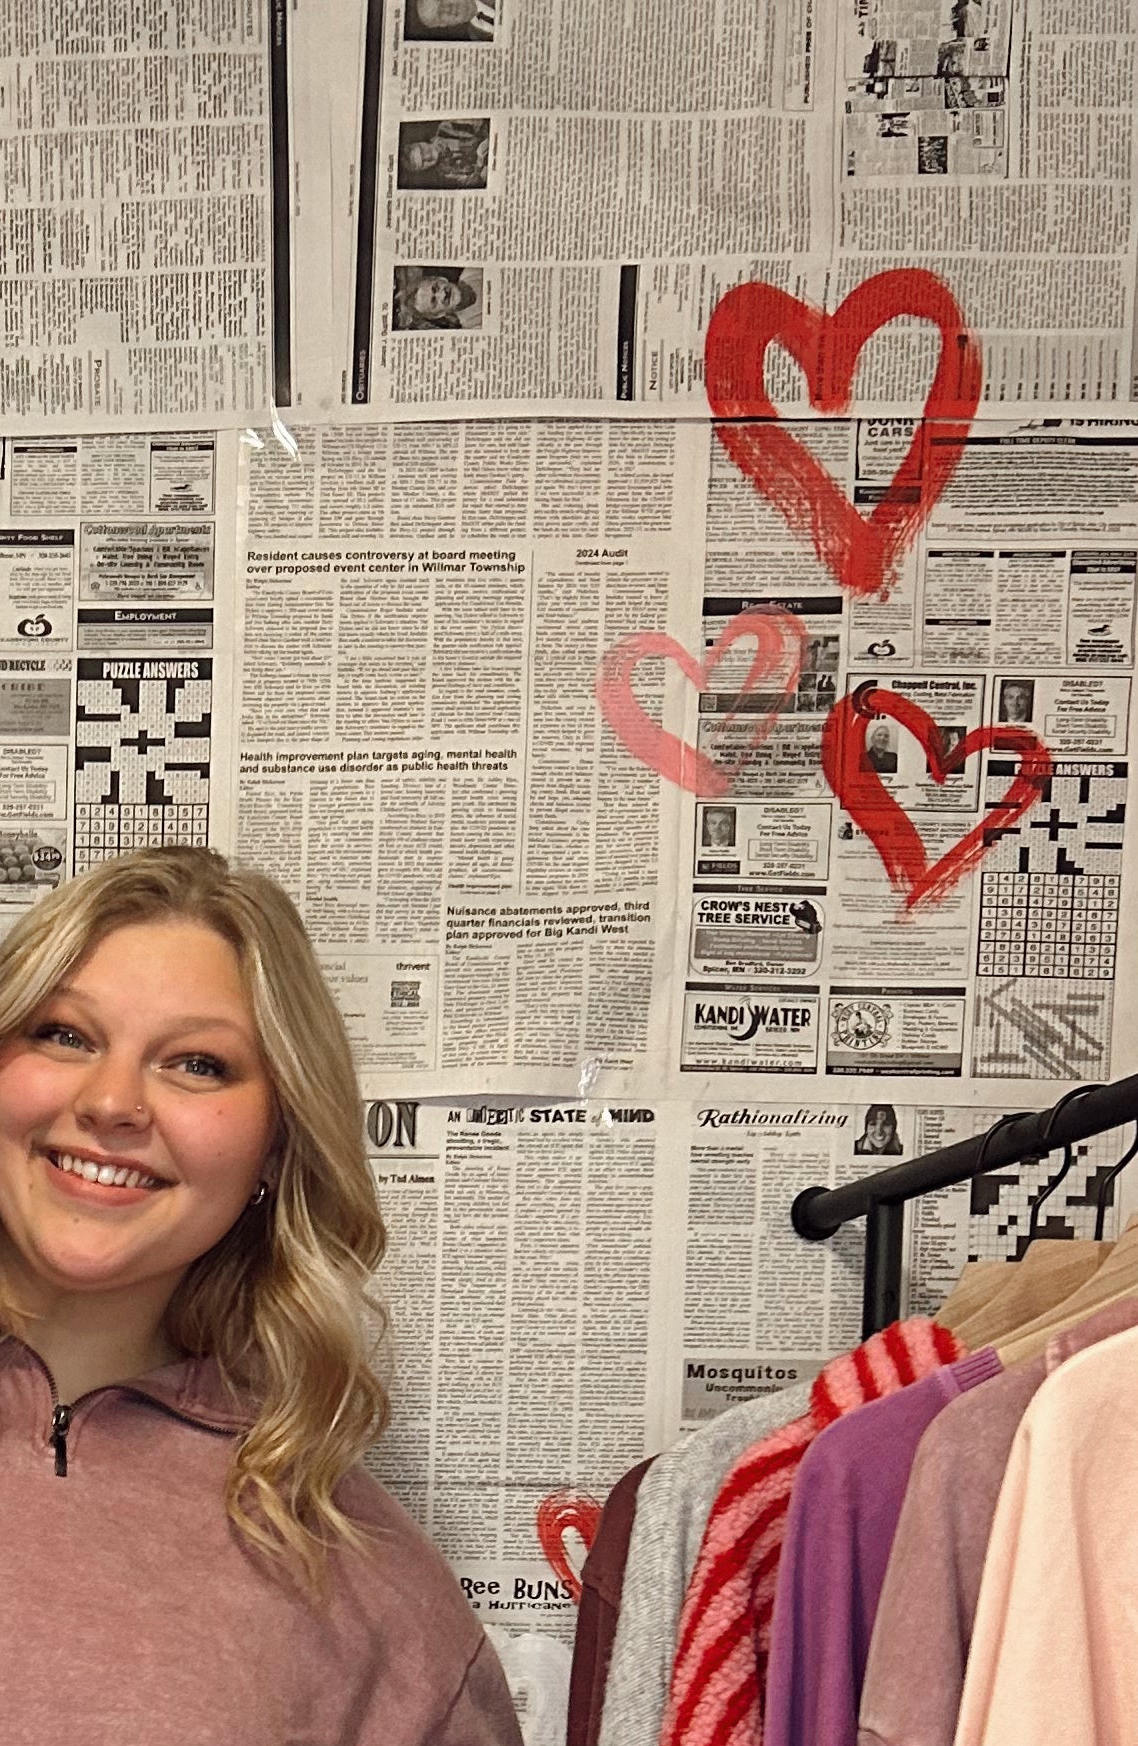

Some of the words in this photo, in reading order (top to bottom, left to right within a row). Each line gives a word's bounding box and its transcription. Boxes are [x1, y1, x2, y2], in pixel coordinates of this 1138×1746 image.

[246, 550, 298, 561] Resident
[300, 551, 342, 560] causes
[345, 550, 414, 562] controversy
[417, 550, 429, 560] at
[431, 549, 466, 560] board
[468, 550, 516, 562] meeting
[575, 548, 599, 558] 2024
[601, 548, 628, 558] Audit
[246, 565, 272, 573] over
[274, 562, 330, 575] proposed
[332, 562, 365, 572] event
[367, 563, 405, 572] center
[407, 561, 419, 572] in
[421, 561, 466, 572] Willmar
[469, 561, 525, 574] Township
[102, 661, 141, 679] PUZZLE
[142, 661, 198, 678] ANSWERS
[239, 751, 273, 761] Health
[275, 751, 344, 762] improvement
[346, 750, 369, 762] plan
[371, 750, 408, 762] targets
[410, 749, 443, 761] aging,
[445, 749, 482, 759] mental
[484, 748, 517, 759] health
[239, 763, 259, 773] and
[261, 763, 315, 773] substance
[317, 764, 337, 773] use
[339, 762, 384, 772] disorder
[385, 763, 398, 771] as
[400, 760, 433, 773] public
[436, 760, 469, 770] health
[471, 760, 508, 770] threats
[700, 900, 750, 912] CROW'S
[753, 901, 790, 912] NEST
[697, 912, 731, 924] TREE
[734, 913, 790, 925] SERVICE
[694, 1003, 744, 1025] KANDI
[759, 1007, 811, 1027] WATER
[529, 1108, 587, 1123] STATE
[697, 1108, 848, 1127] Rathionalizing
[686, 1363, 797, 1381] Mosquitos
